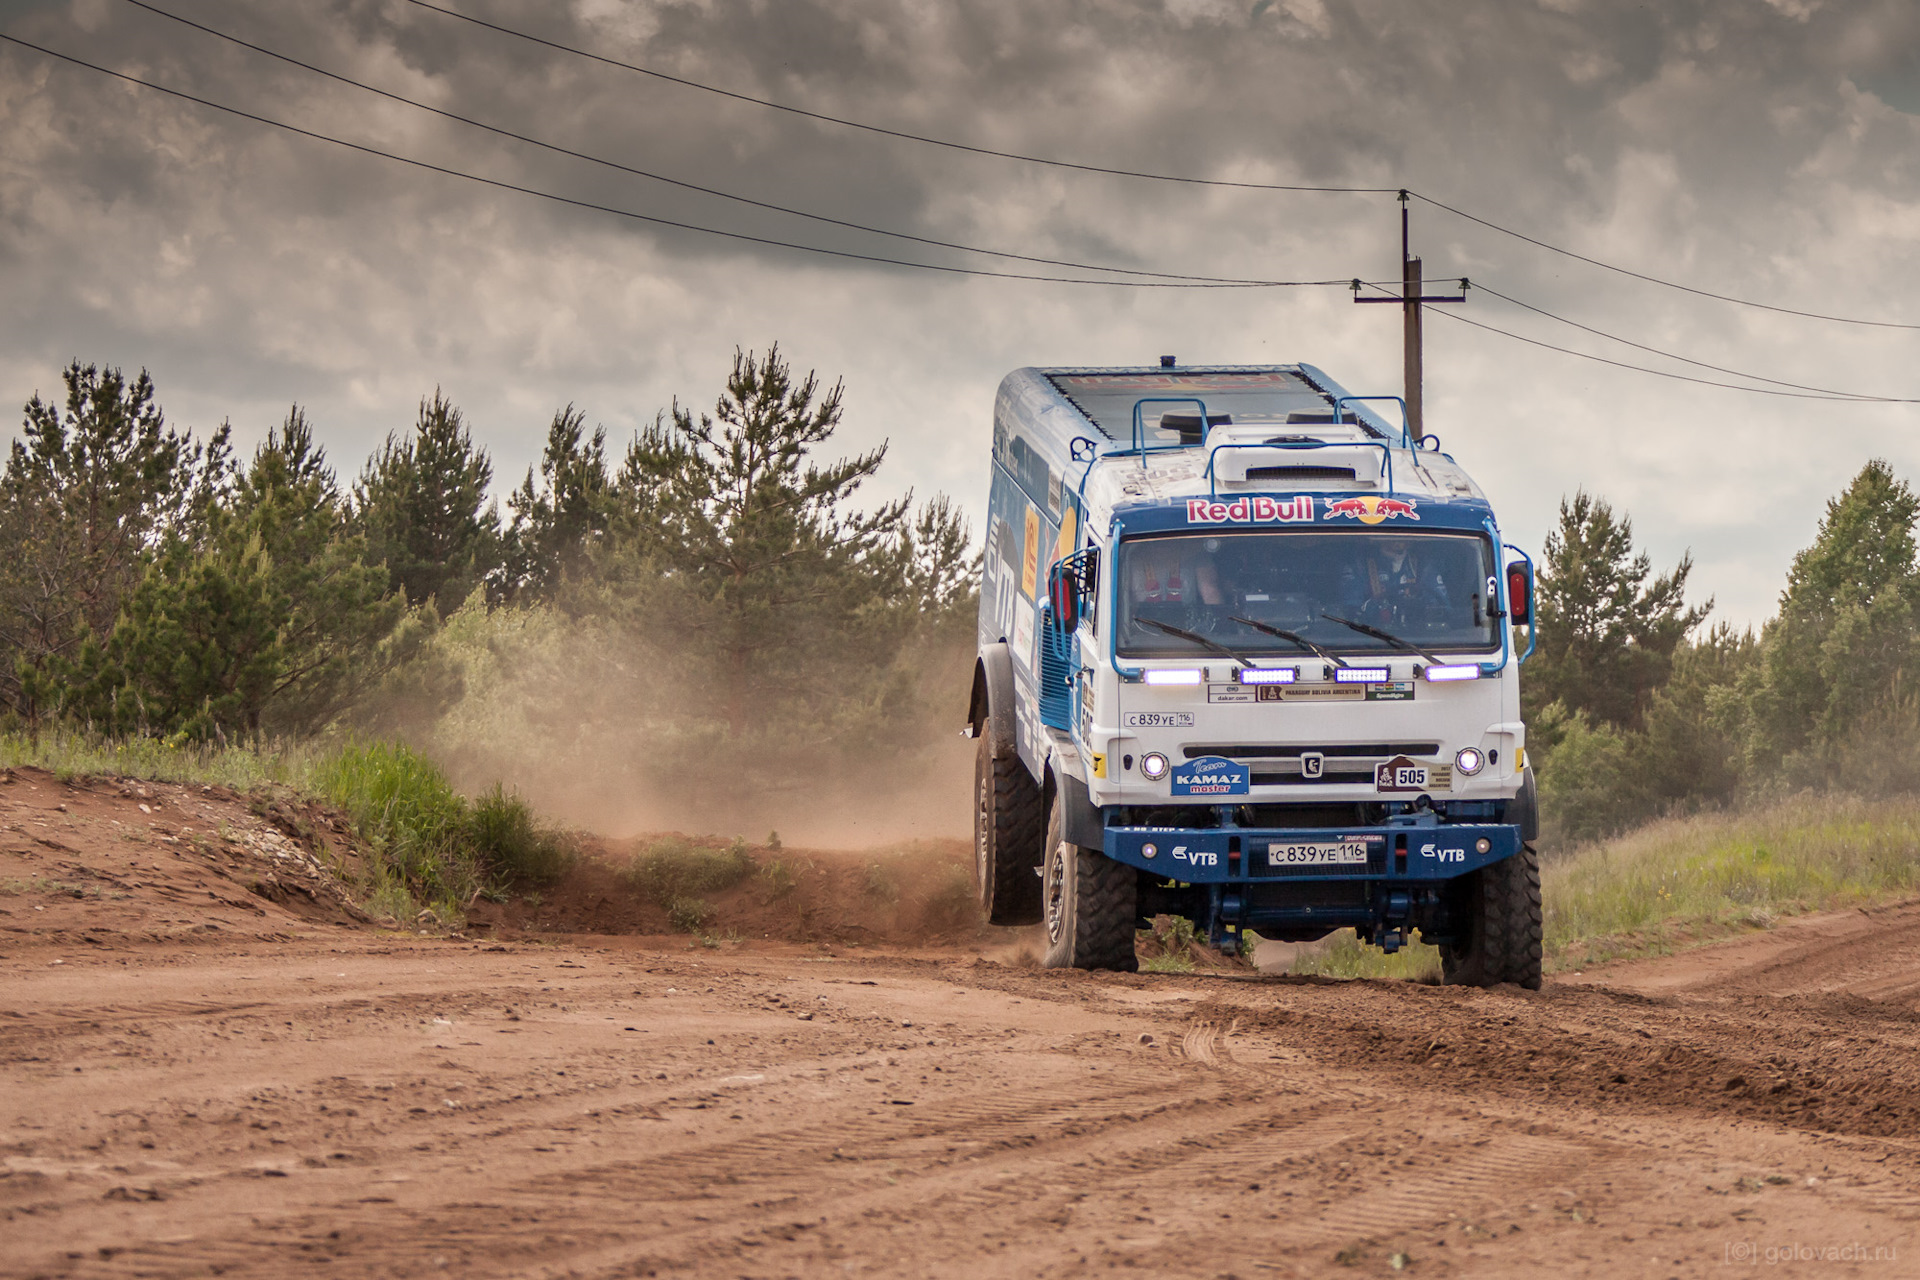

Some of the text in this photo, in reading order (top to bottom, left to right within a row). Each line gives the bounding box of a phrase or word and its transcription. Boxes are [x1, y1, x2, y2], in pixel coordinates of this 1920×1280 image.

[1188, 496, 1313, 522] Red Bull
[1178, 714, 1191, 722] 116
[1192, 758, 1227, 774] Team
[1176, 774, 1242, 785] KAMAZ
[1399, 769, 1425, 784] 505
[1190, 784, 1231, 793] master
[1339, 844, 1362, 857] 116
[1437, 849, 1465, 862] VTB
[1188, 852, 1218, 866] VTB
